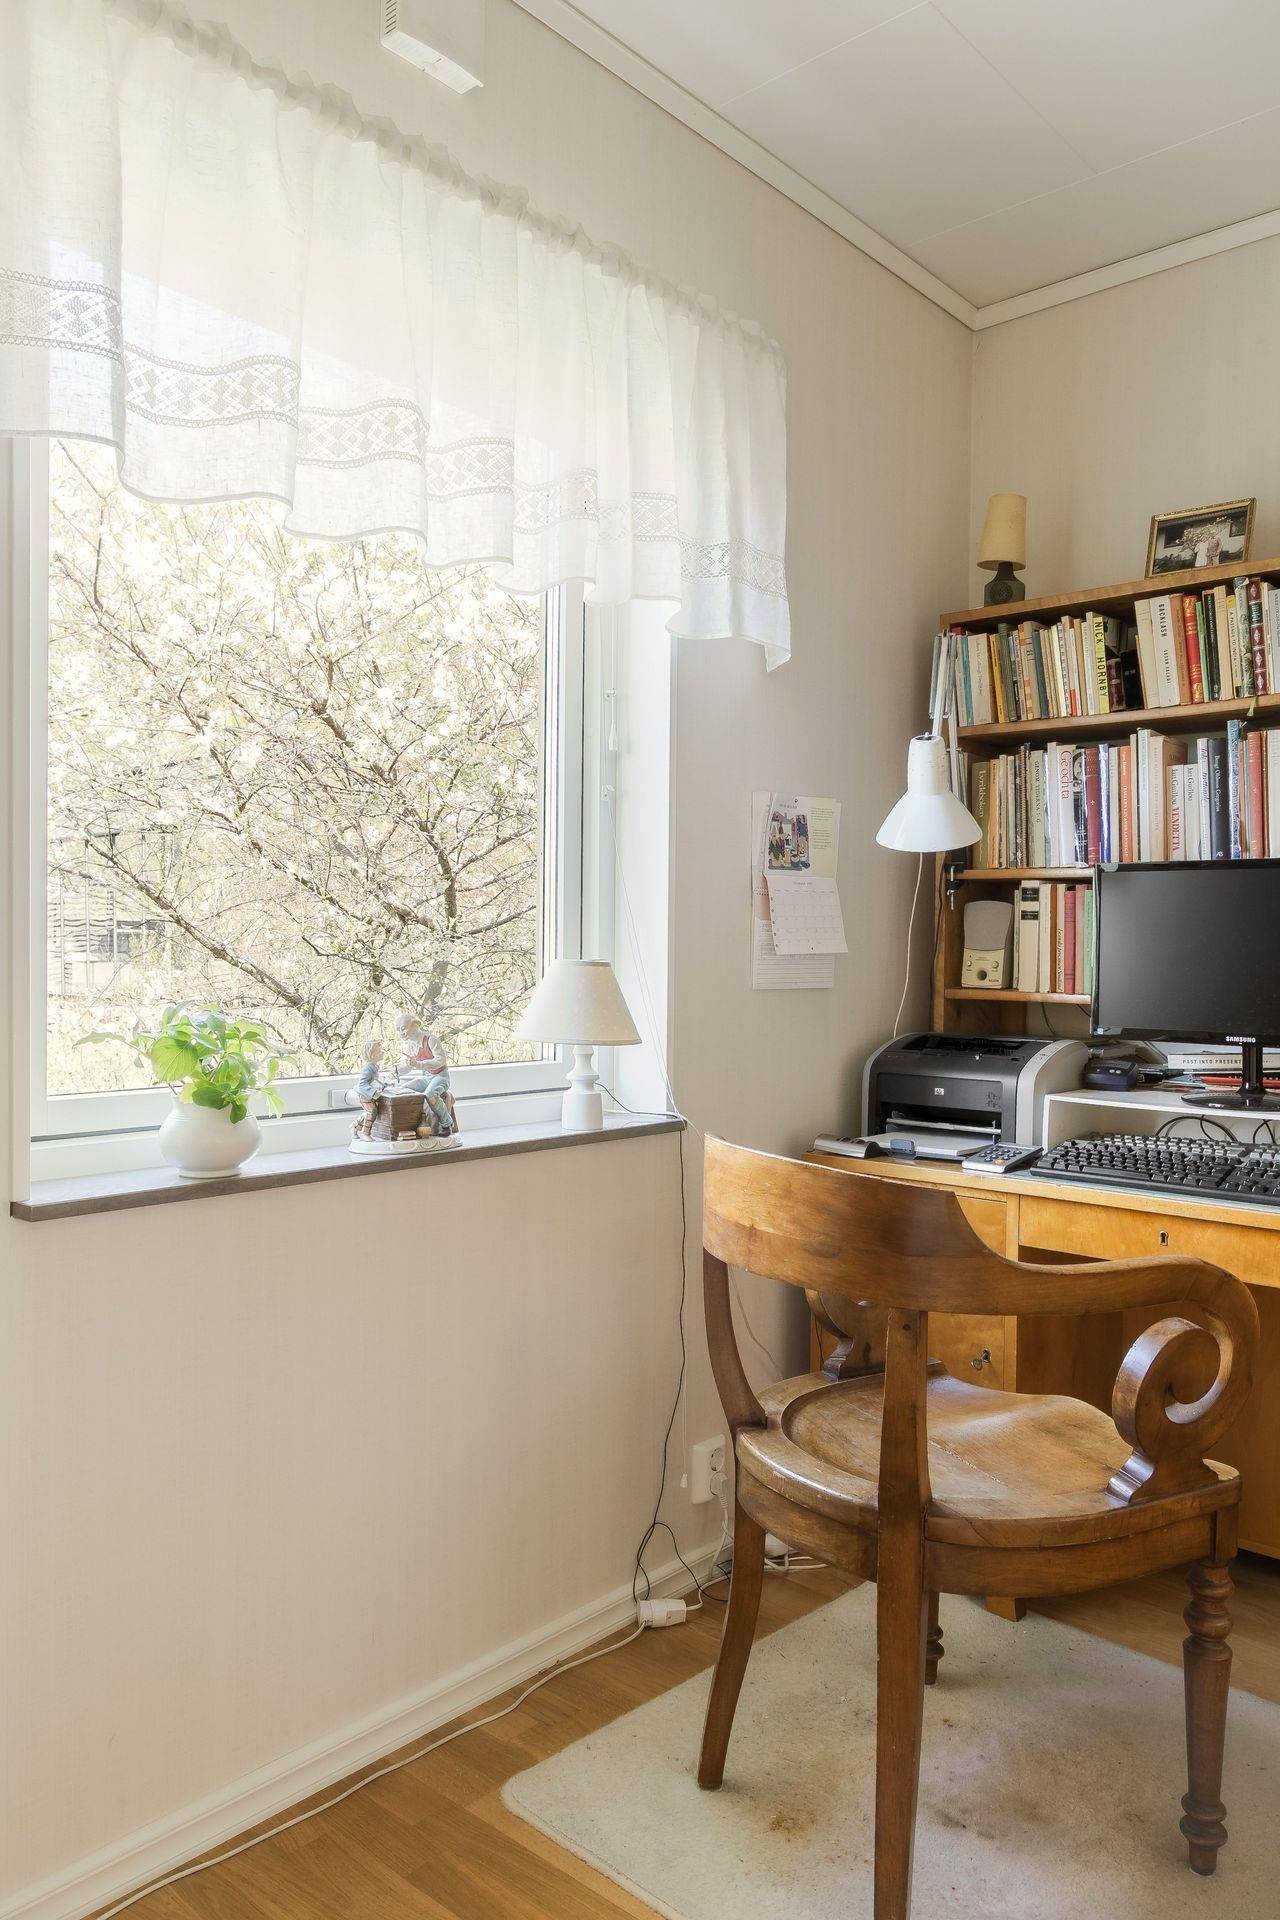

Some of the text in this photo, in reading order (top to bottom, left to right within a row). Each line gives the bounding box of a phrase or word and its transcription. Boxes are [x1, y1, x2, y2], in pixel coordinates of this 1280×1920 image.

[1158, 604, 1167, 637] BACKLASH
[1094, 622, 1107, 697] NICK HORNBY
[1062, 768, 1072, 787] och
[1061, 790, 1071, 799] ta
[1172, 807, 1180, 851] VENDETTA
